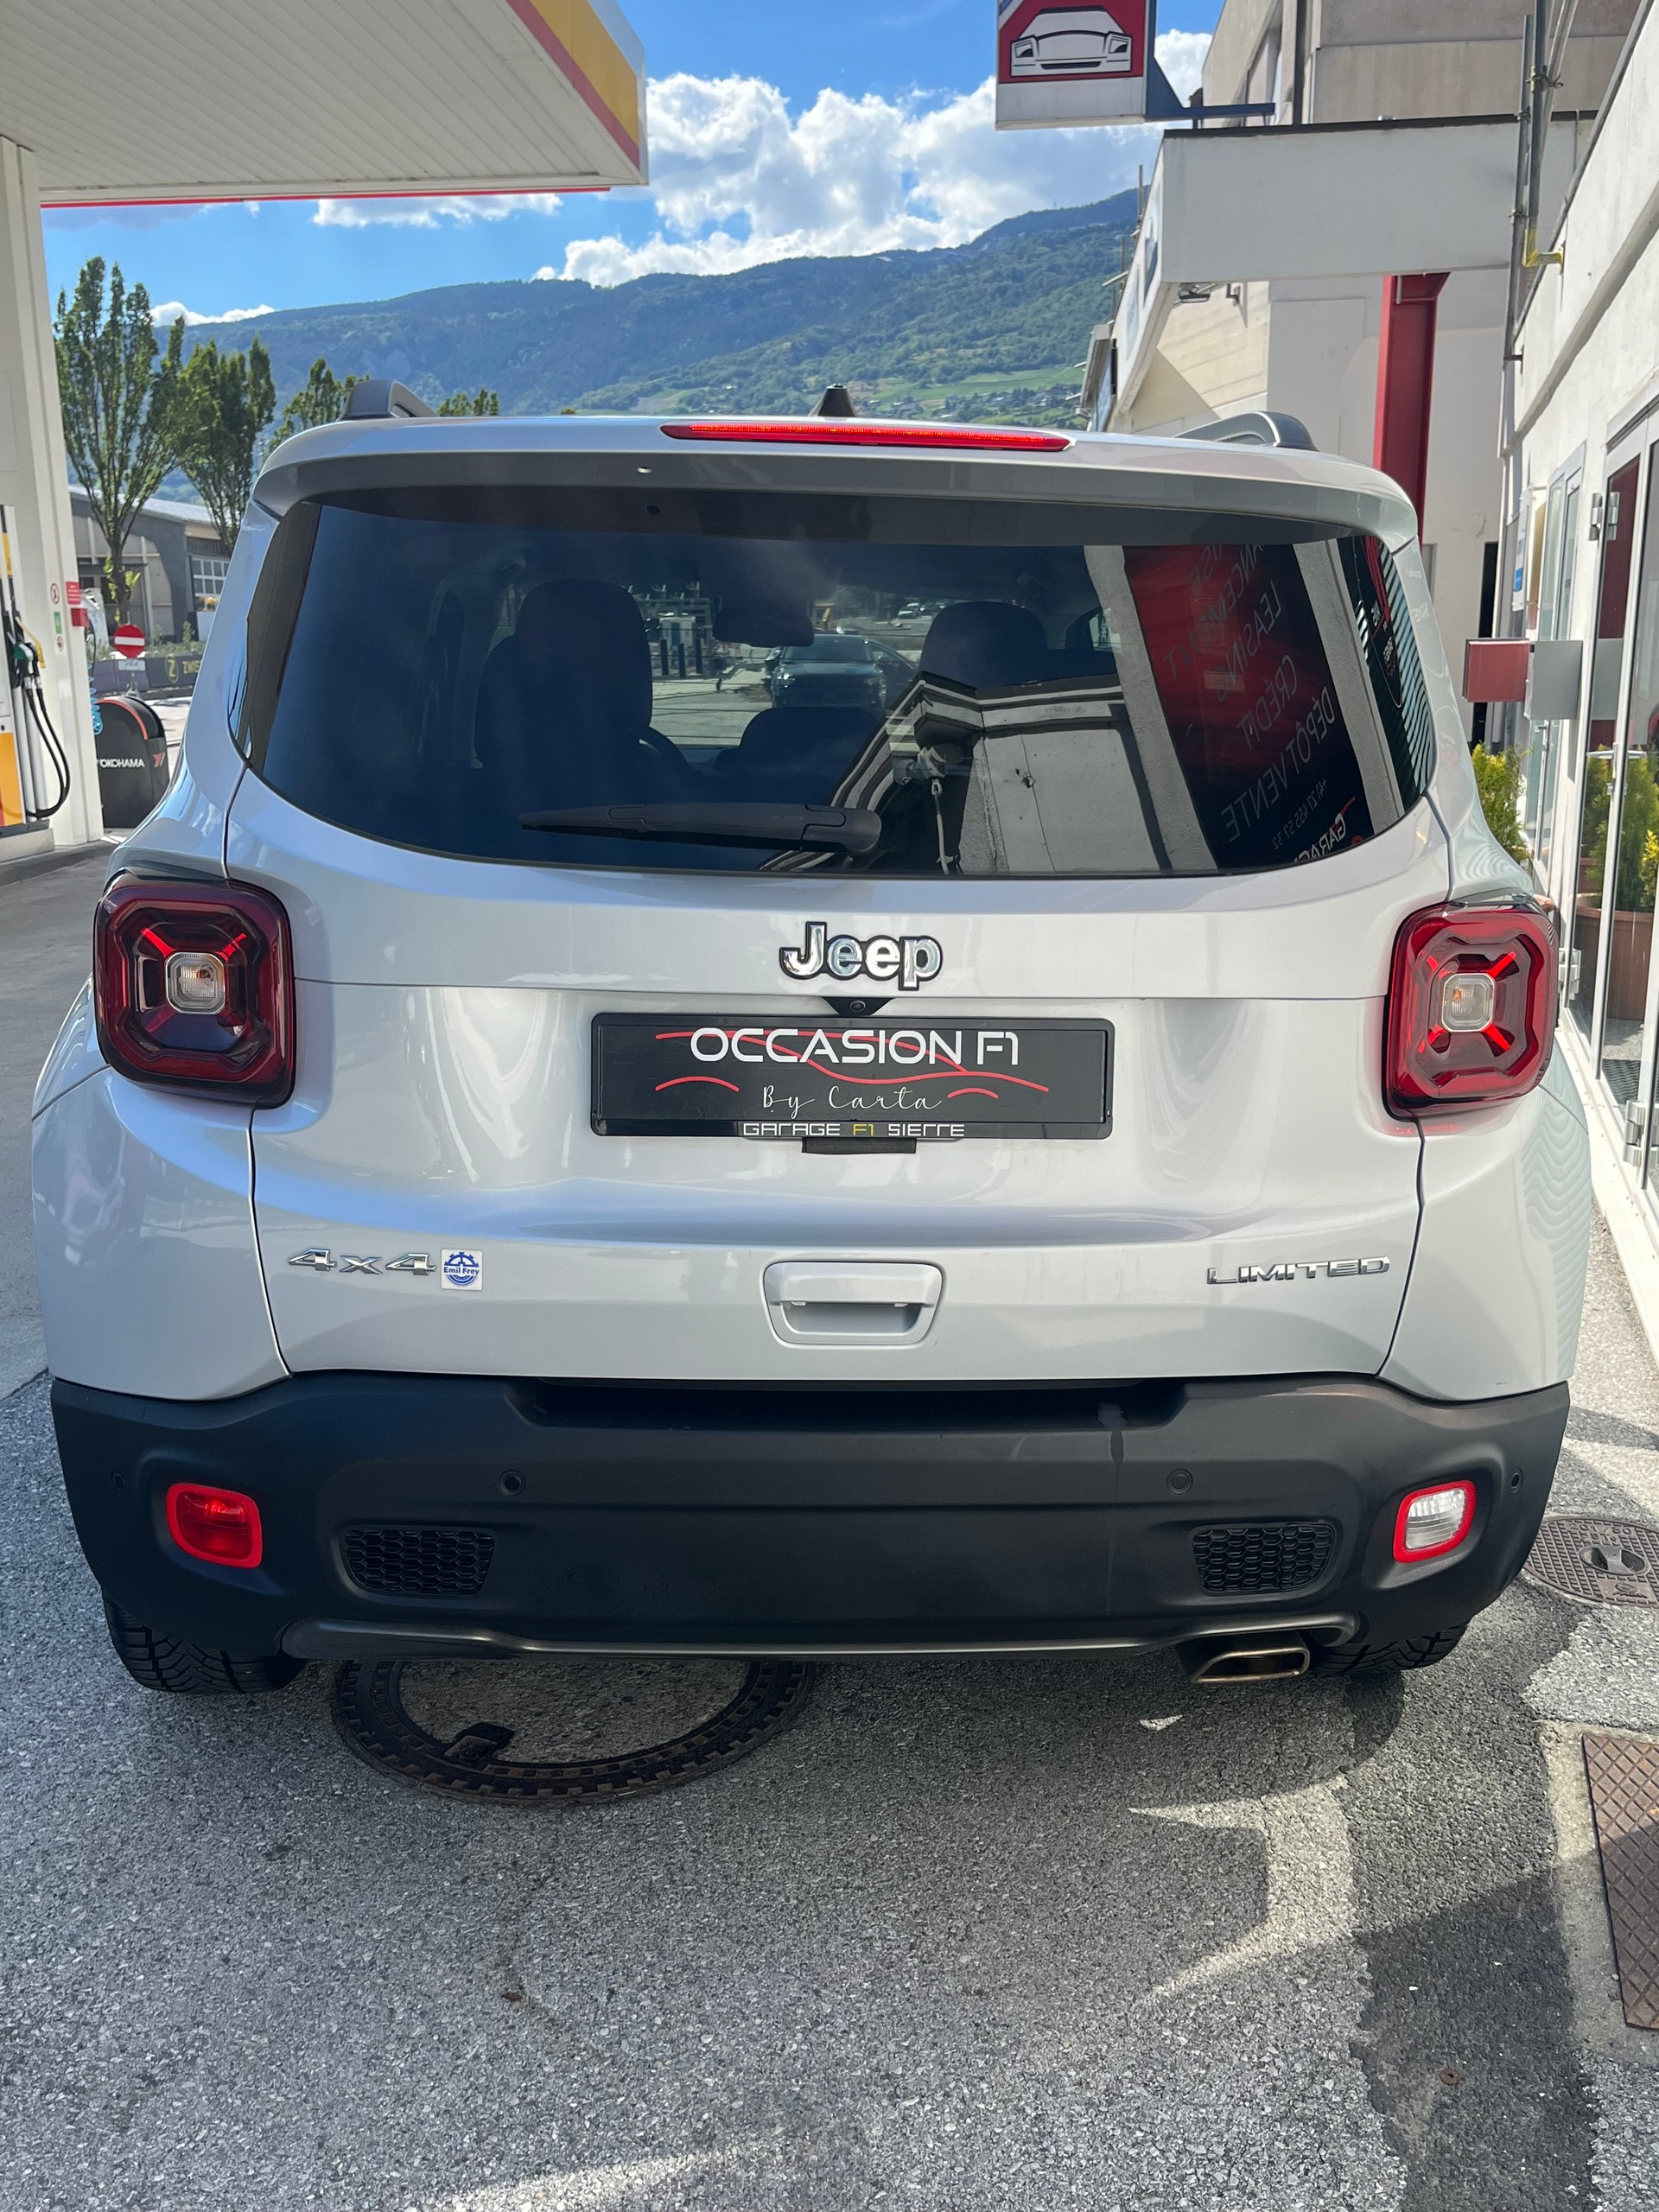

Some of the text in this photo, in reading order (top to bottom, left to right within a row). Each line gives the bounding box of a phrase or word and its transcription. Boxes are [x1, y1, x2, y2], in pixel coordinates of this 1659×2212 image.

[97, 758, 146, 768] OKOHAMA
[779, 921, 944, 991] Jeep
[691, 1027, 1020, 1066] OCCASION F1
[762, 1084, 943, 1119] By Carta
[743, 1122, 965, 1137] GARAGE F1 SIERRE
[443, 1266, 480, 1276] Emil Frey
[1206, 1255, 1391, 1285] LIMITED
